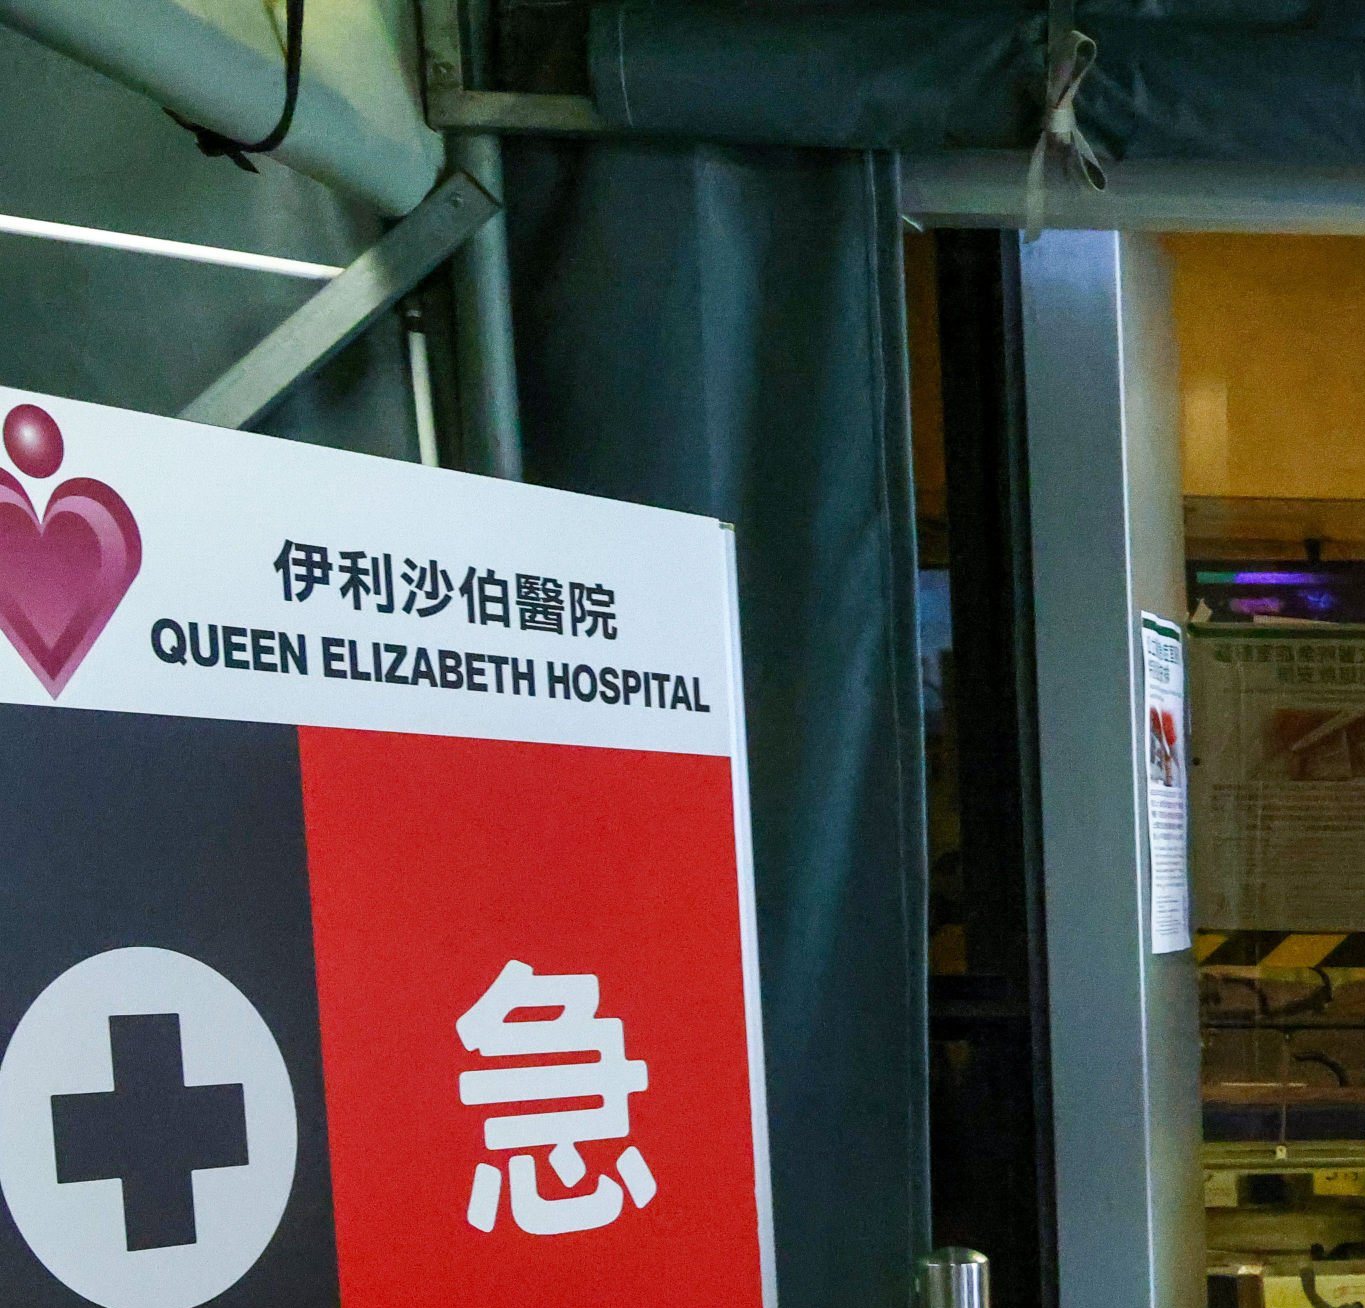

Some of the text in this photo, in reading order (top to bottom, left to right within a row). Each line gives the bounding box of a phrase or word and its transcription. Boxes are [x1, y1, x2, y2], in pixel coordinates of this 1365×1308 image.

[273, 539, 618, 641] 伊利沙伯醫院
[151, 618, 711, 713] QUEEN ELIZABETH HOSPITAL
